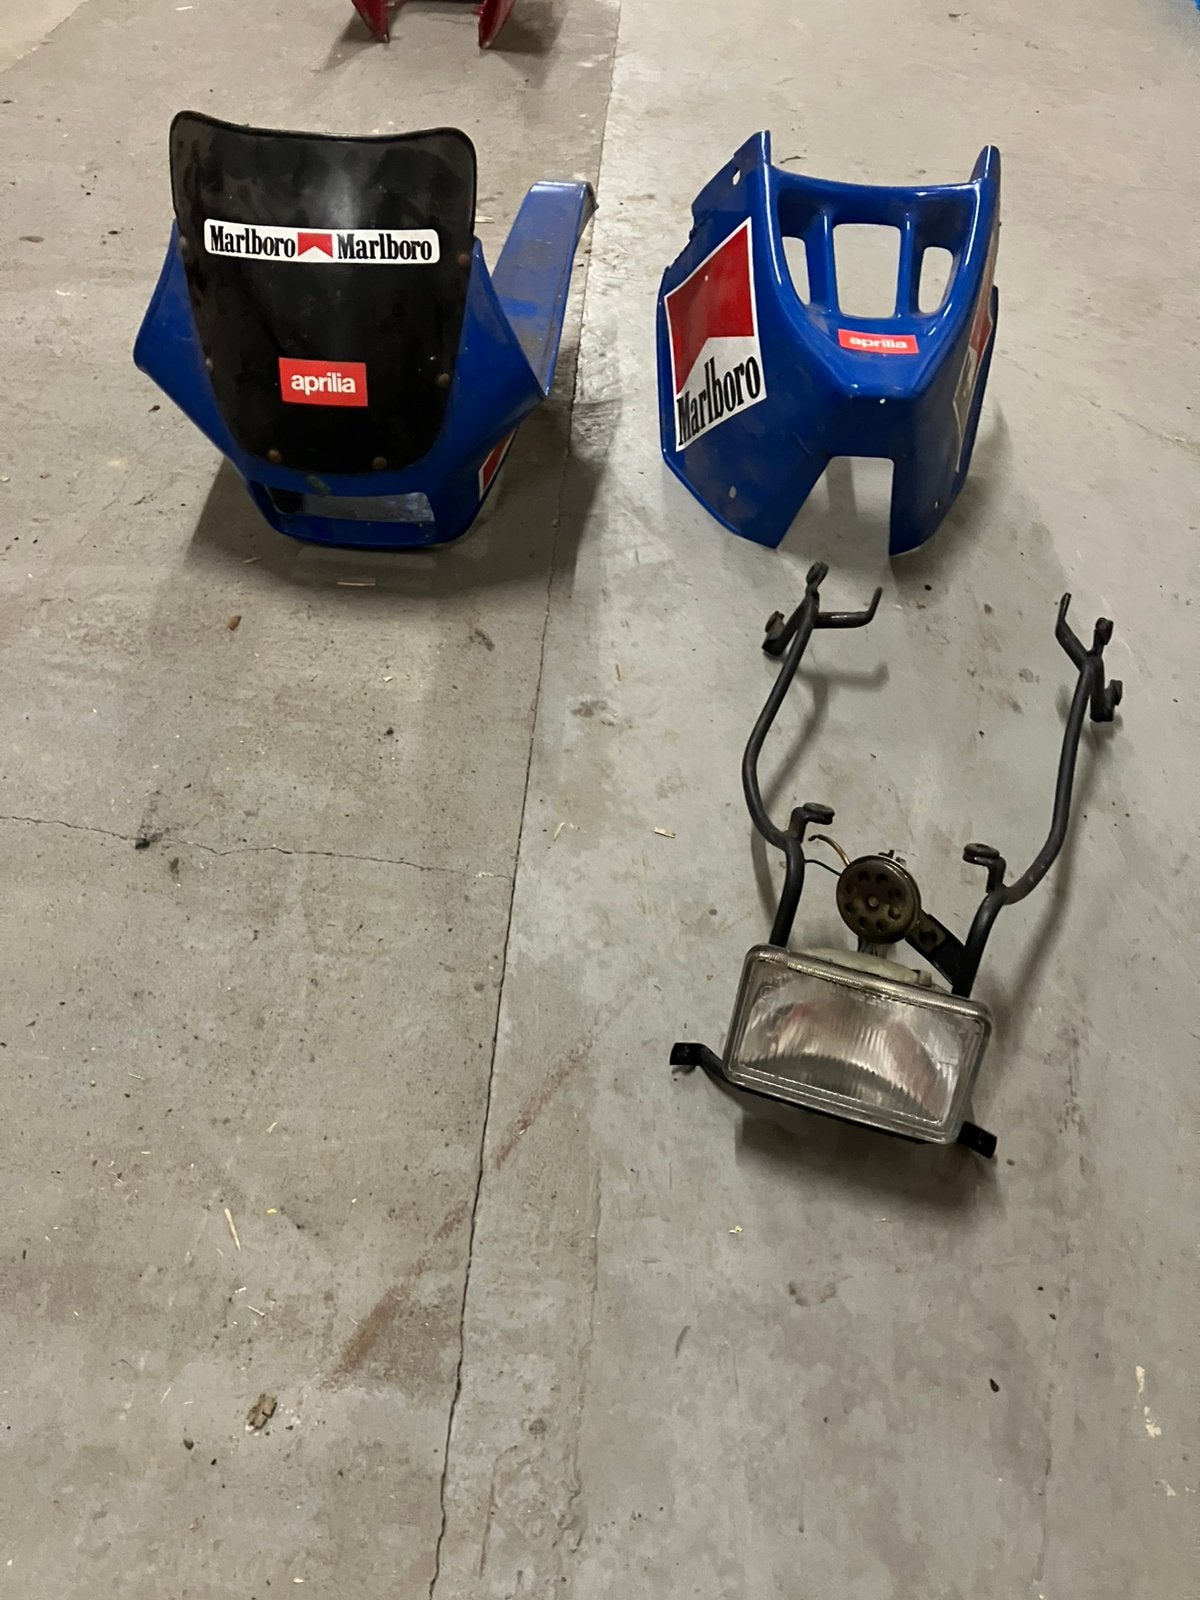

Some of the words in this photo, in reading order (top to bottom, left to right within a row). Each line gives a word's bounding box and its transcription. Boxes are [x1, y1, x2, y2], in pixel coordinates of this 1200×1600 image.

[209, 225, 296, 258] Marlboro
[336, 233, 432, 260] Marlboro
[849, 337, 908, 349] aprilia
[291, 372, 356, 395] aprilia
[676, 356, 760, 446] Marlboro
